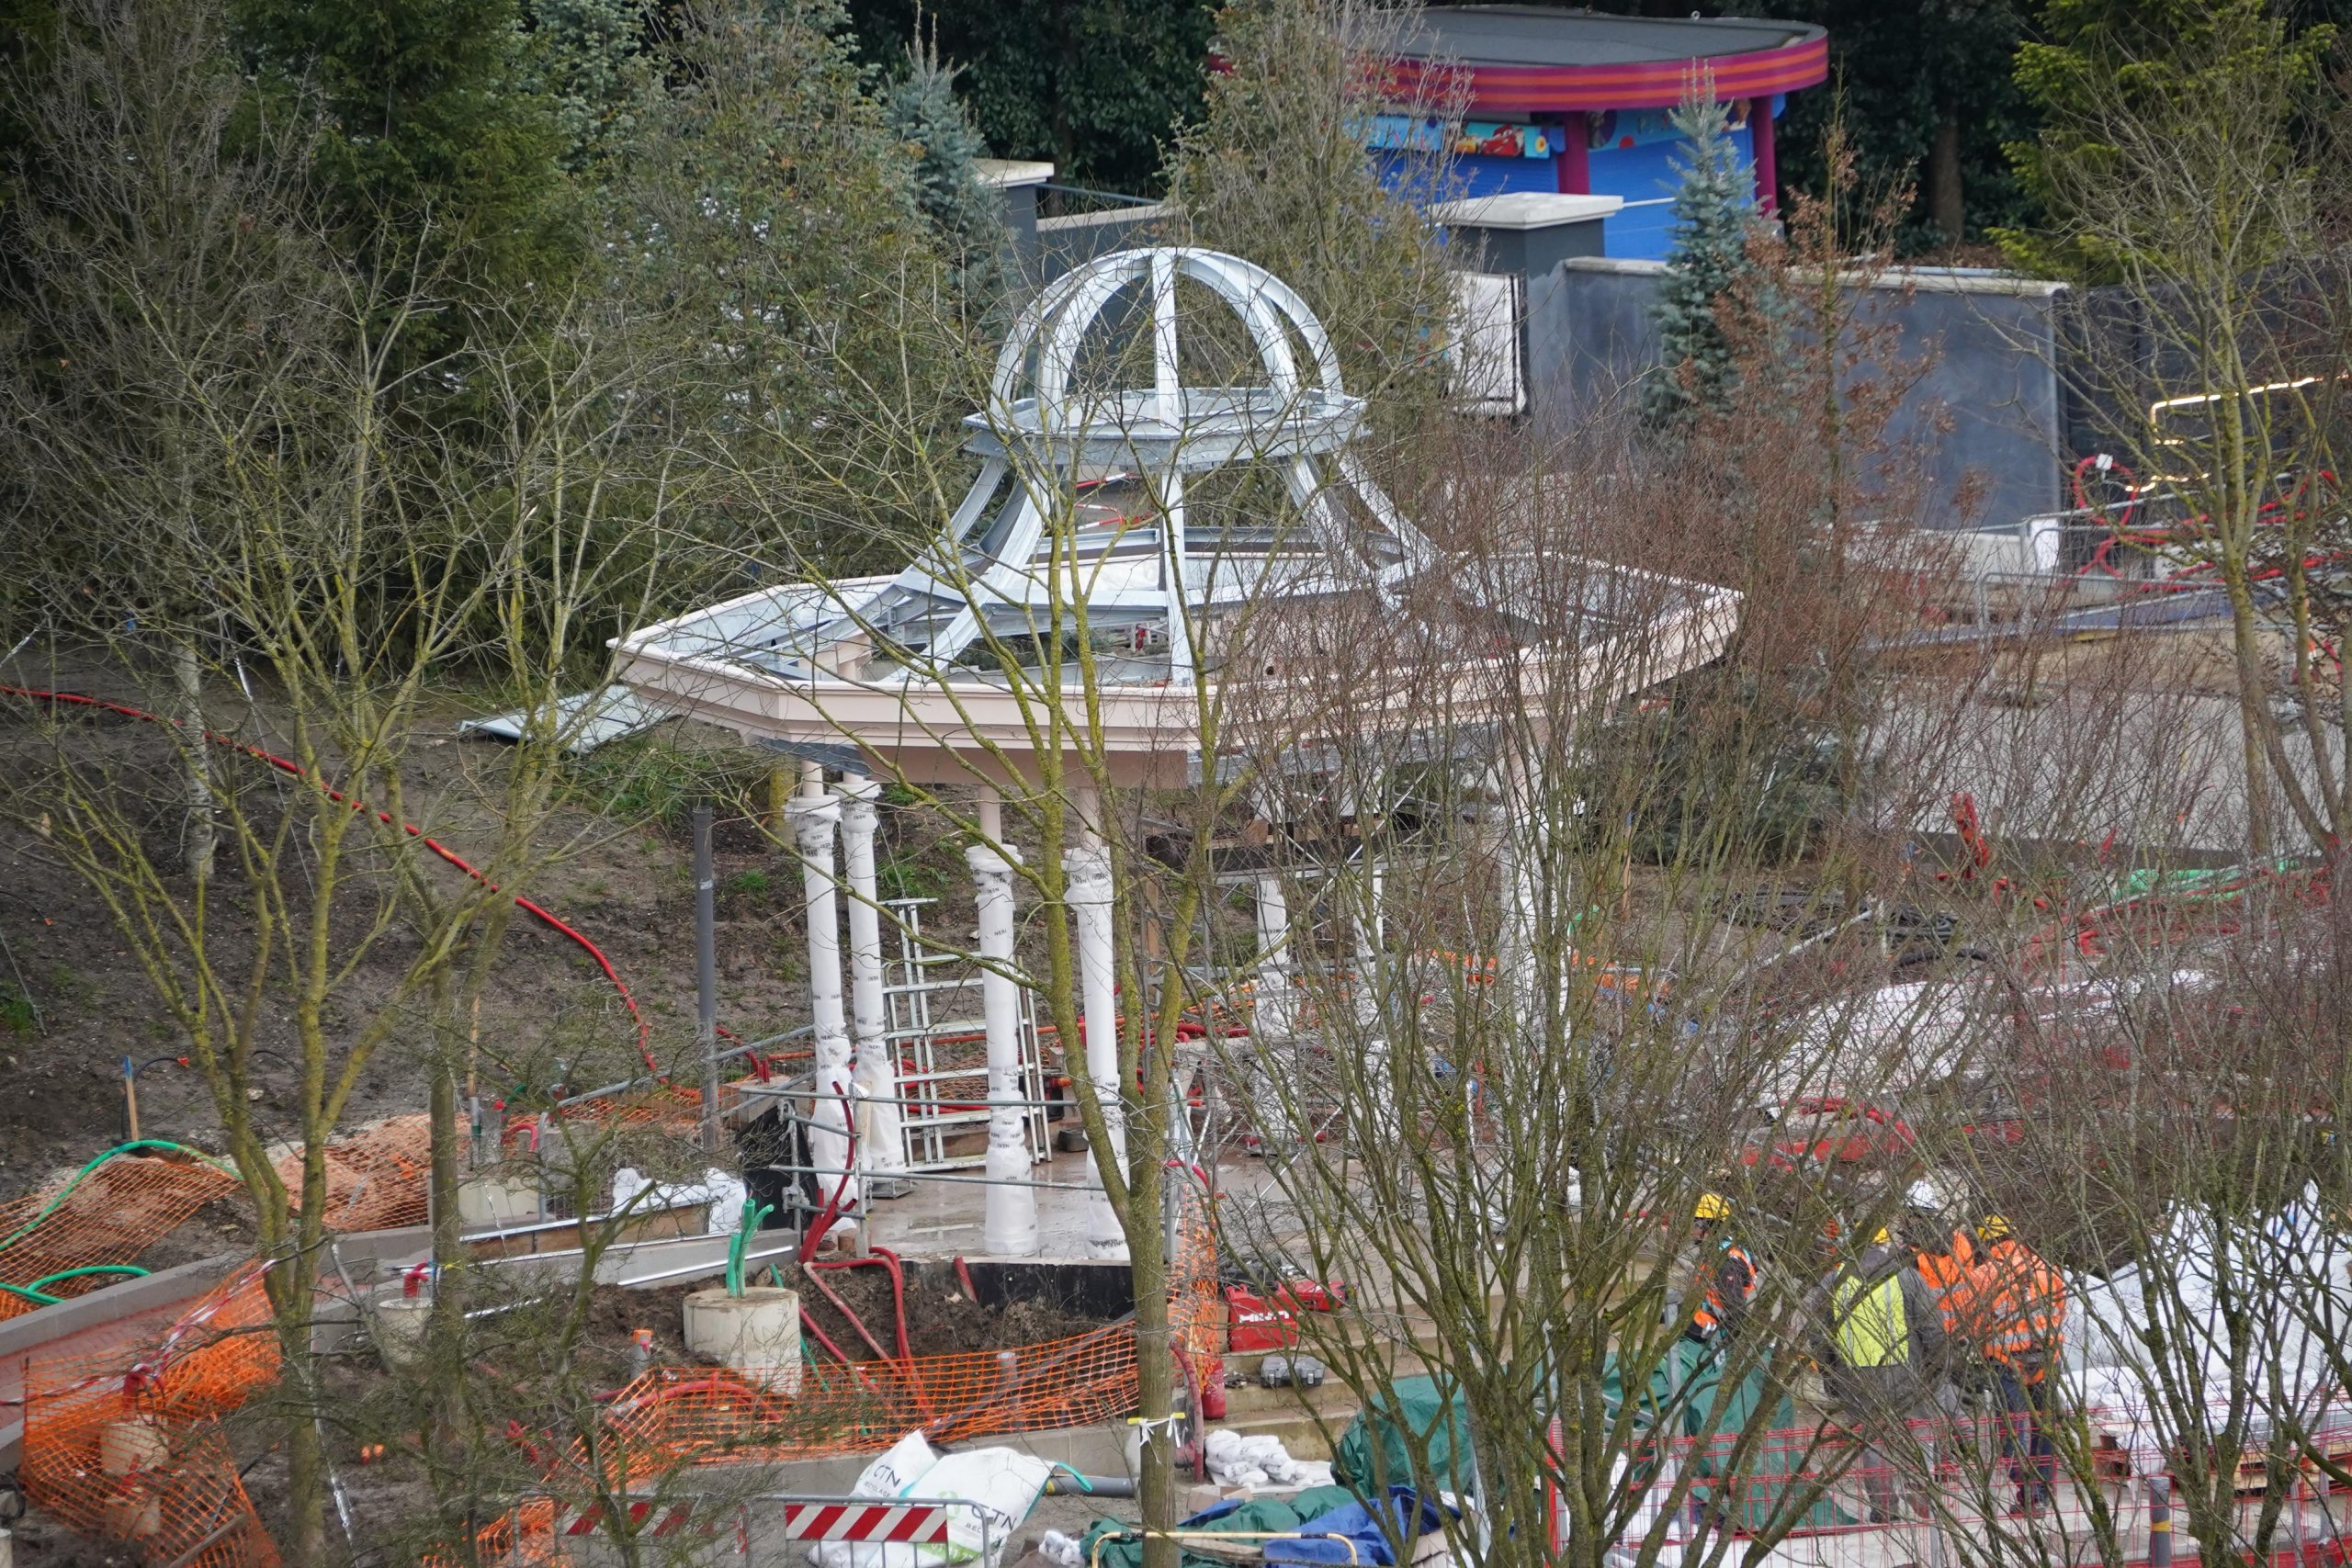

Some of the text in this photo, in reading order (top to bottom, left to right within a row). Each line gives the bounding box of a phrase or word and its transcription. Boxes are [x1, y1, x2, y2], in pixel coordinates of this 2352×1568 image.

[1238, 1310, 1290, 1323] HILTI
[874, 1464, 901, 1488] CTN
[971, 1503, 1017, 1531] CTN
